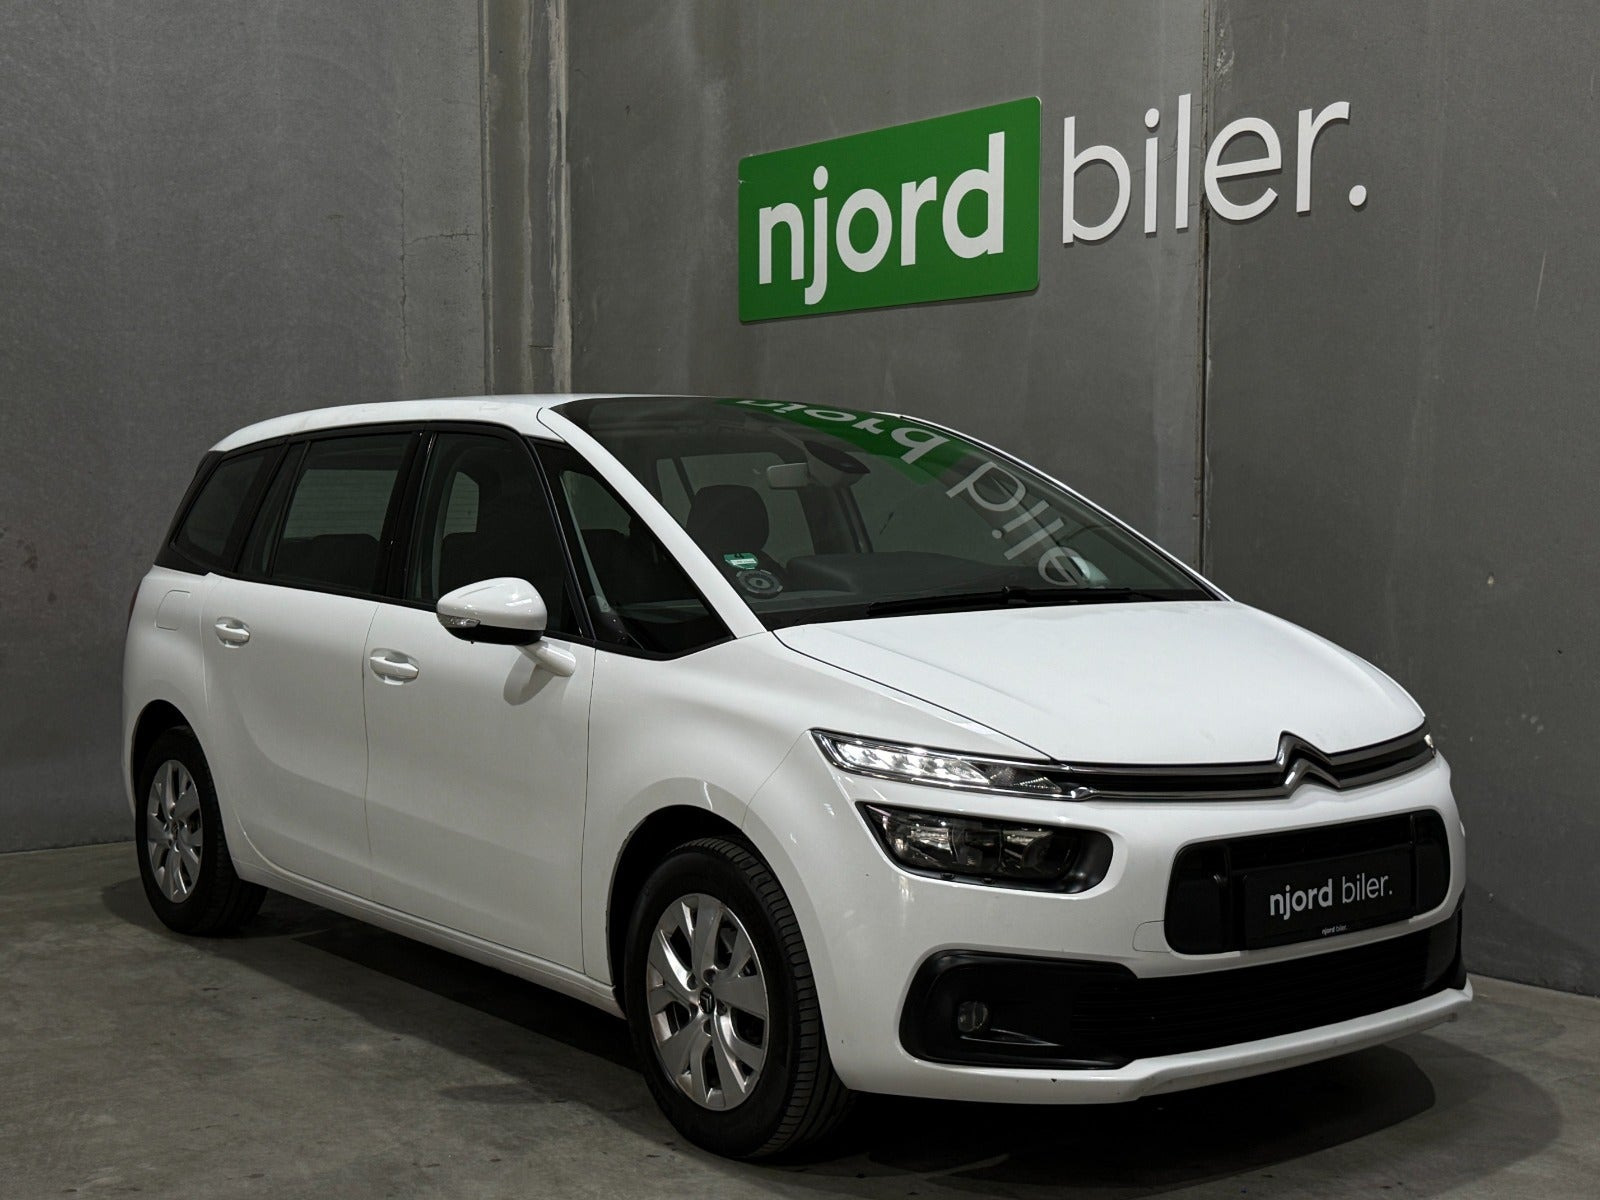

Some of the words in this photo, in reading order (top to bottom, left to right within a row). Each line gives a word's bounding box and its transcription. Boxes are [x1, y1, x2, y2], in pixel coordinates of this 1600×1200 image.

[759, 131, 1005, 305] njord
[1062, 93, 1367, 244] biler.
[1269, 877, 1333, 920] njord
[1341, 873, 1393, 904] biler.
